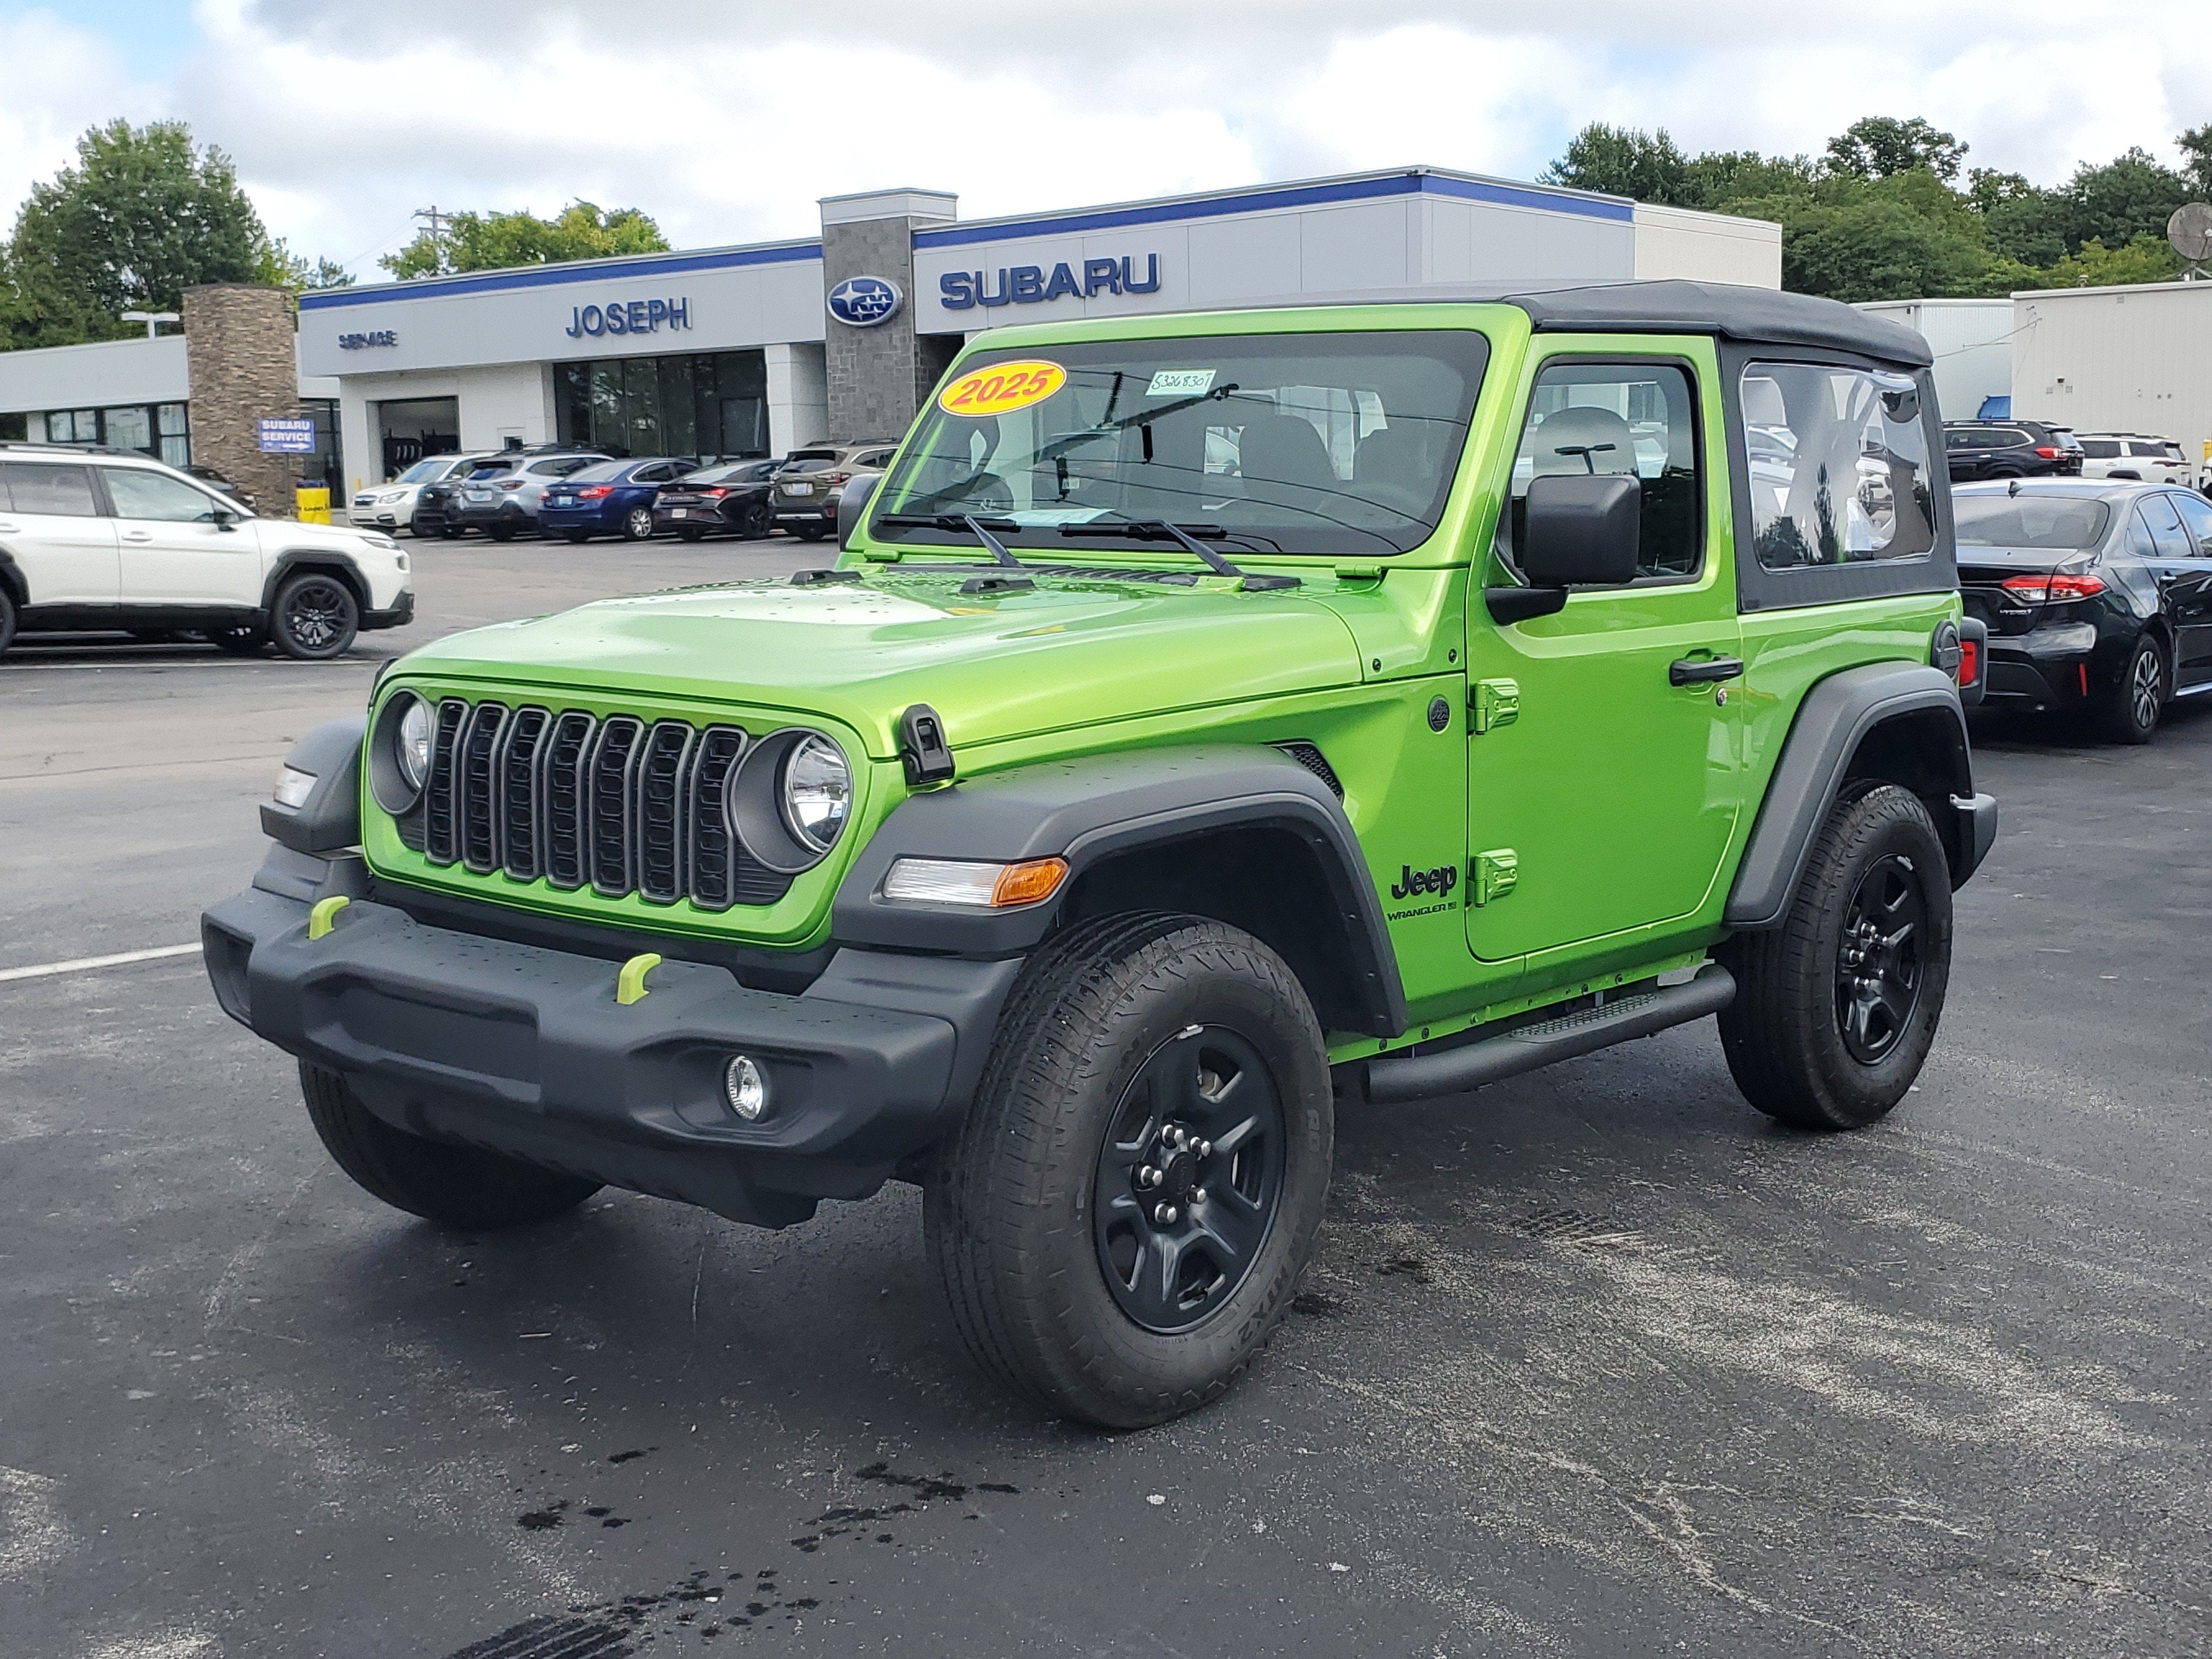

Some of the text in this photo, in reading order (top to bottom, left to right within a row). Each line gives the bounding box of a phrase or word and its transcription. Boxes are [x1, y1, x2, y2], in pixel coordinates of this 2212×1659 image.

[940, 253, 1161, 310] SUBARU
[566, 297, 693, 338] JOSEPH
[950, 368, 1056, 407] 2025
[262, 420, 311, 430] SUBARU
[262, 431, 312, 442] SERVICE
[1391, 864, 1457, 900] Jeep
[1387, 903, 1446, 922] WRANGLER
